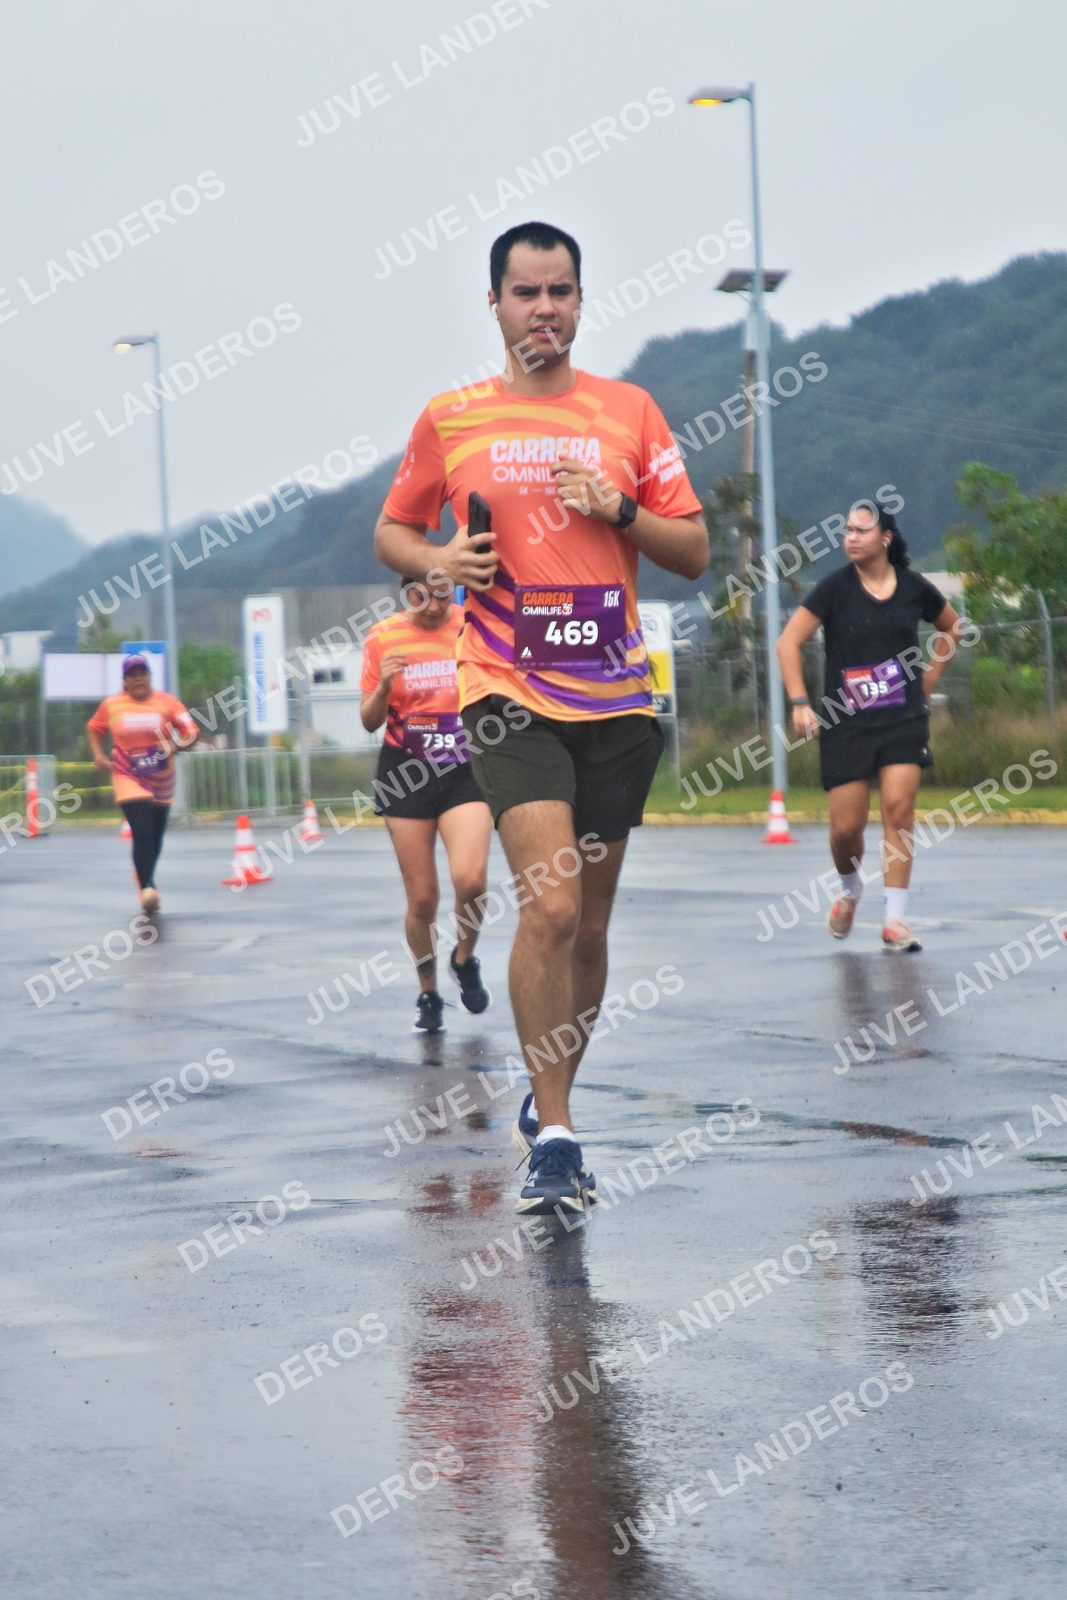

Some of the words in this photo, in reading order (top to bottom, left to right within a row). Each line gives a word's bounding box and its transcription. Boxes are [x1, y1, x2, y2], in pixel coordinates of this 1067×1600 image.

[491, 436, 601, 464] CARRERA
[492, 465, 557, 482] OMNIL
[522, 592, 574, 606] CARRERA
[522, 605, 562, 615] OMNILIFE
[545, 620, 599, 646] 469
[861, 681, 888, 697] 135
[422, 733, 456, 748] 739
